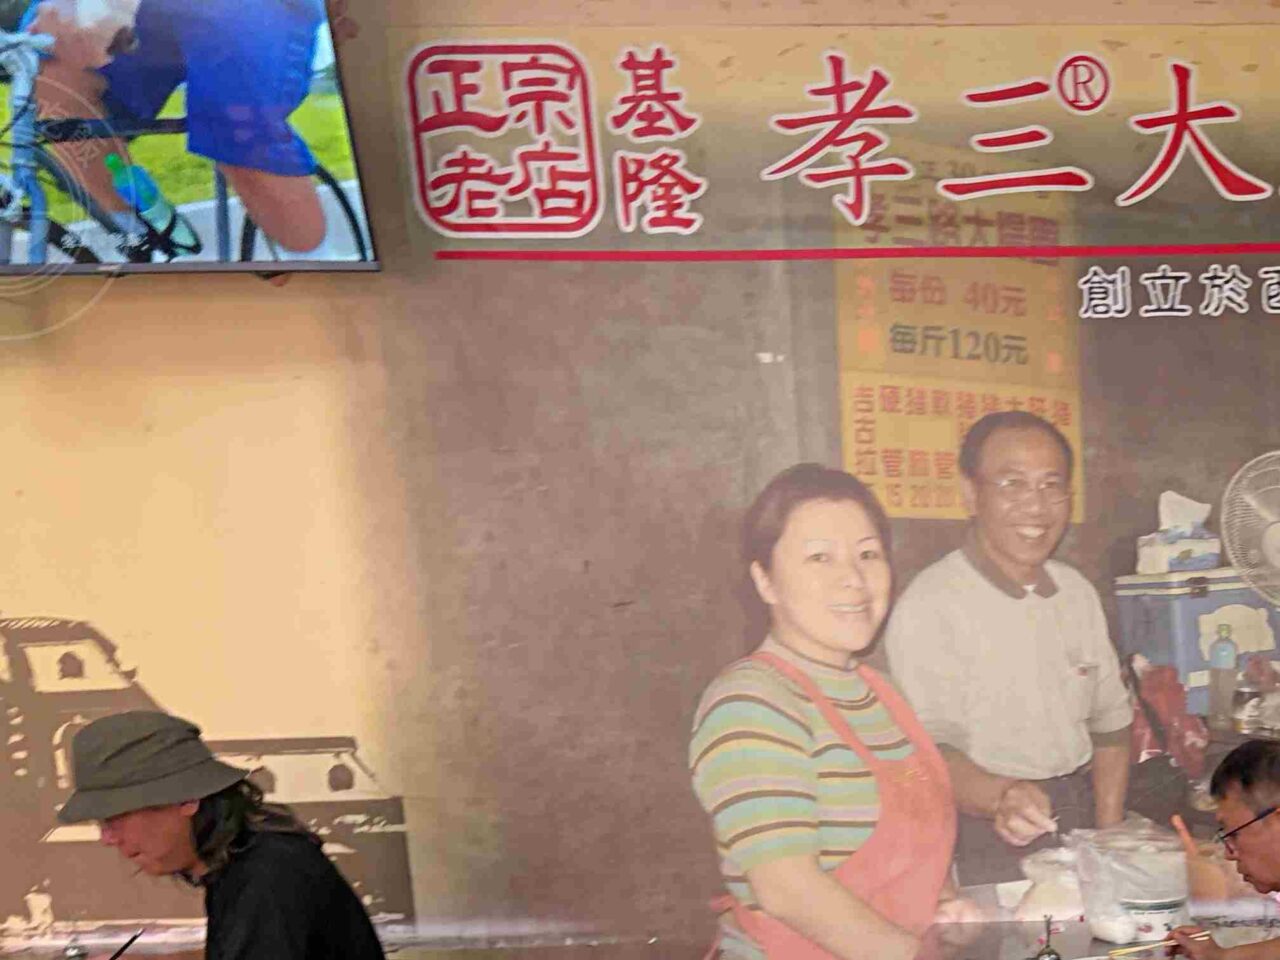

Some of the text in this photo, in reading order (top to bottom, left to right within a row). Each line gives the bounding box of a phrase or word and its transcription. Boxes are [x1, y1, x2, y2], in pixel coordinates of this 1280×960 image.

[418, 56, 578, 134] 正宗
[610, 46, 705, 234] 基隆
[428, 142, 593, 218] 老店
